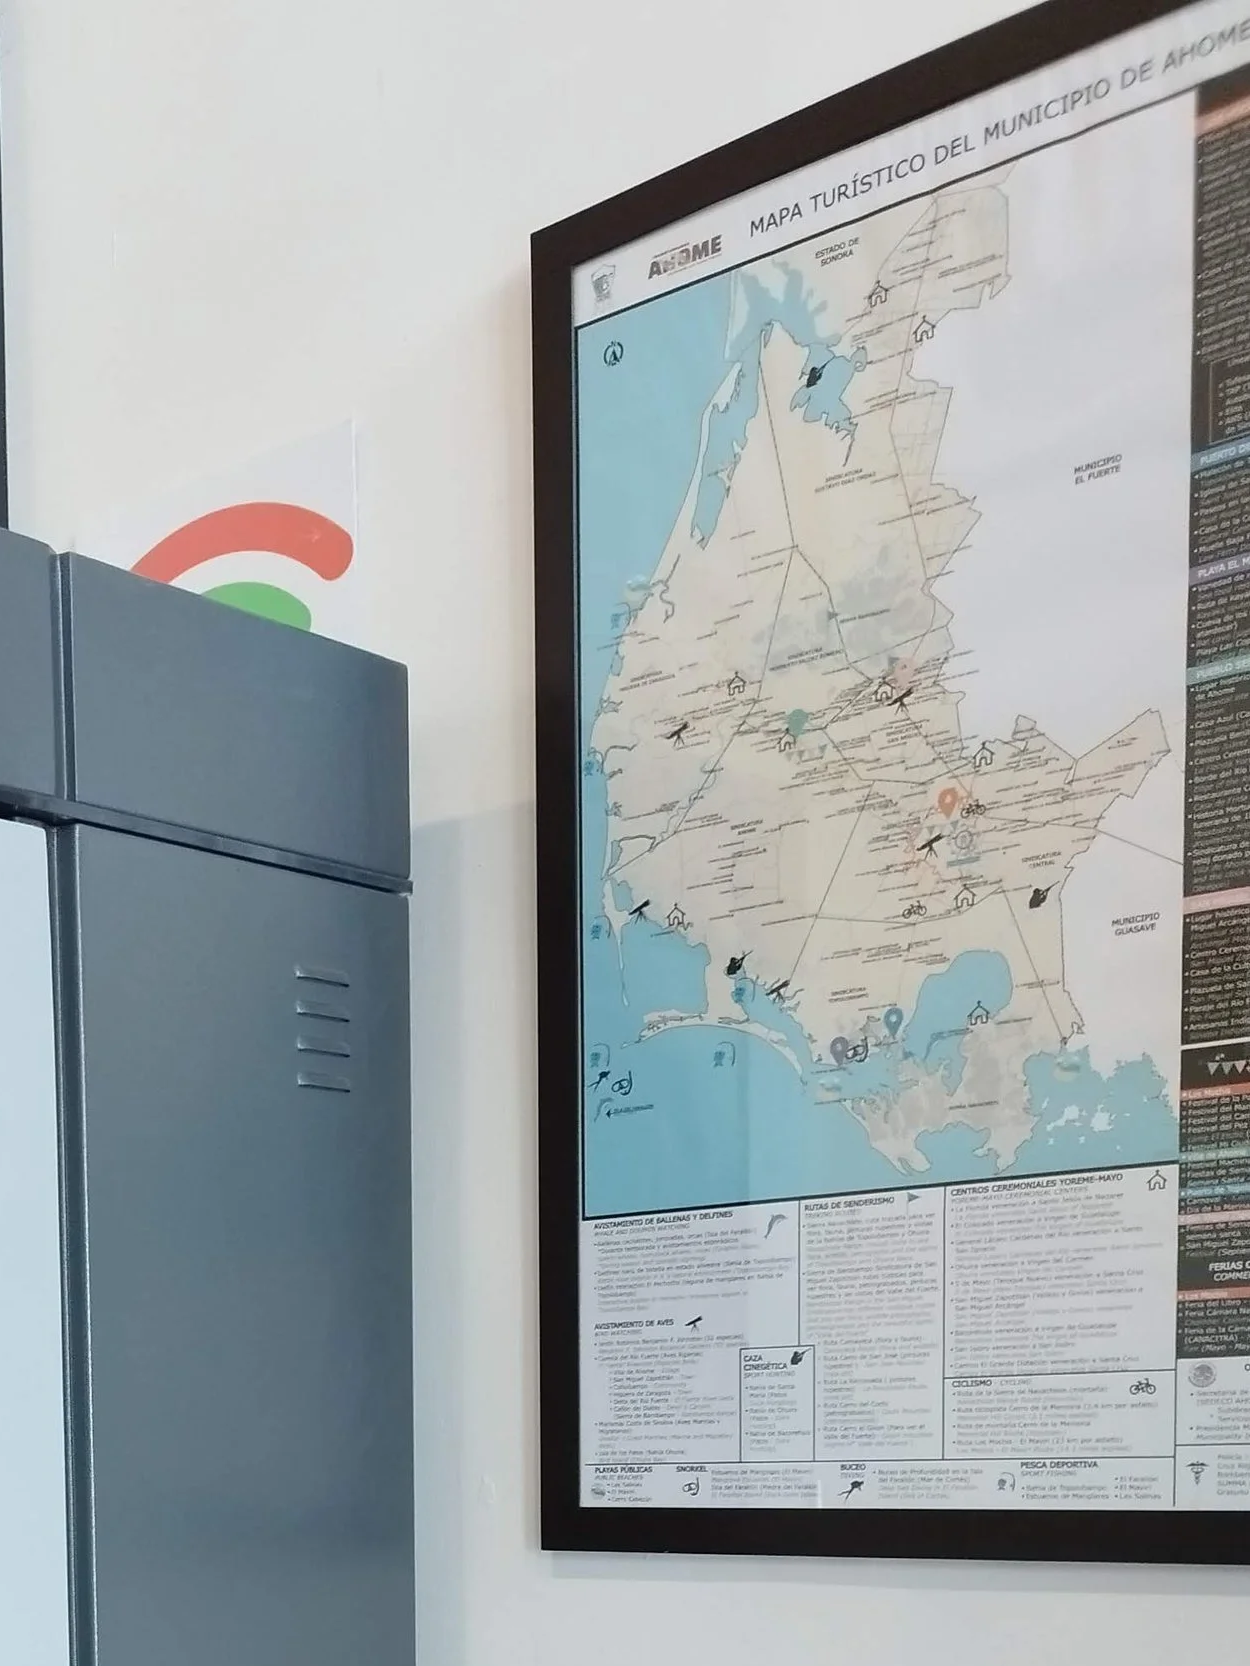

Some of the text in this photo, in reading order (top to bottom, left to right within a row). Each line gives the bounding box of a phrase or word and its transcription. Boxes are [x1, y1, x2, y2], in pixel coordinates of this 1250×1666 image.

[750, 18, 1250, 237] MAPA TURÍSTICO DEL MUNICIPIO DE AHOME
[815, 237, 860, 259] ESTADO DE
[820, 250, 854, 267] SONORA
[1074, 454, 1123, 475] MUNICIPIO
[1075, 464, 1121, 485] EL FUERTE
[1111, 912, 1160, 927] MUNICIPIO
[1115, 923, 1156, 936] GUASAVE
[951, 1173, 1123, 1197] CENTROS CEREMONIALES YOREME-MAYO
[804, 1204, 828, 1212] RUTAS
[843, 1197, 894, 1209] SENDERISMO
[594, 1219, 643, 1229] AVISTAMIENTO
[645, 1217, 654, 1225] DE
[656, 1214, 691, 1224] BALLENAS
[699, 1211, 733, 1220] DELFINES
[1209, 1261, 1244, 1271] FERIAS
[594, 1321, 644, 1330] AVISTAMIENTO
[657, 1319, 674, 1327] AVES
[744, 1362, 787, 1371] CINEGÉTICA
[952, 1380, 992, 1388] CICLISMO
[620, 1465, 653, 1474] PÚBLICAS
[840, 1463, 866, 1471] BUCEO
[1020, 1461, 1099, 1469] PESCA DEPORTIVA
